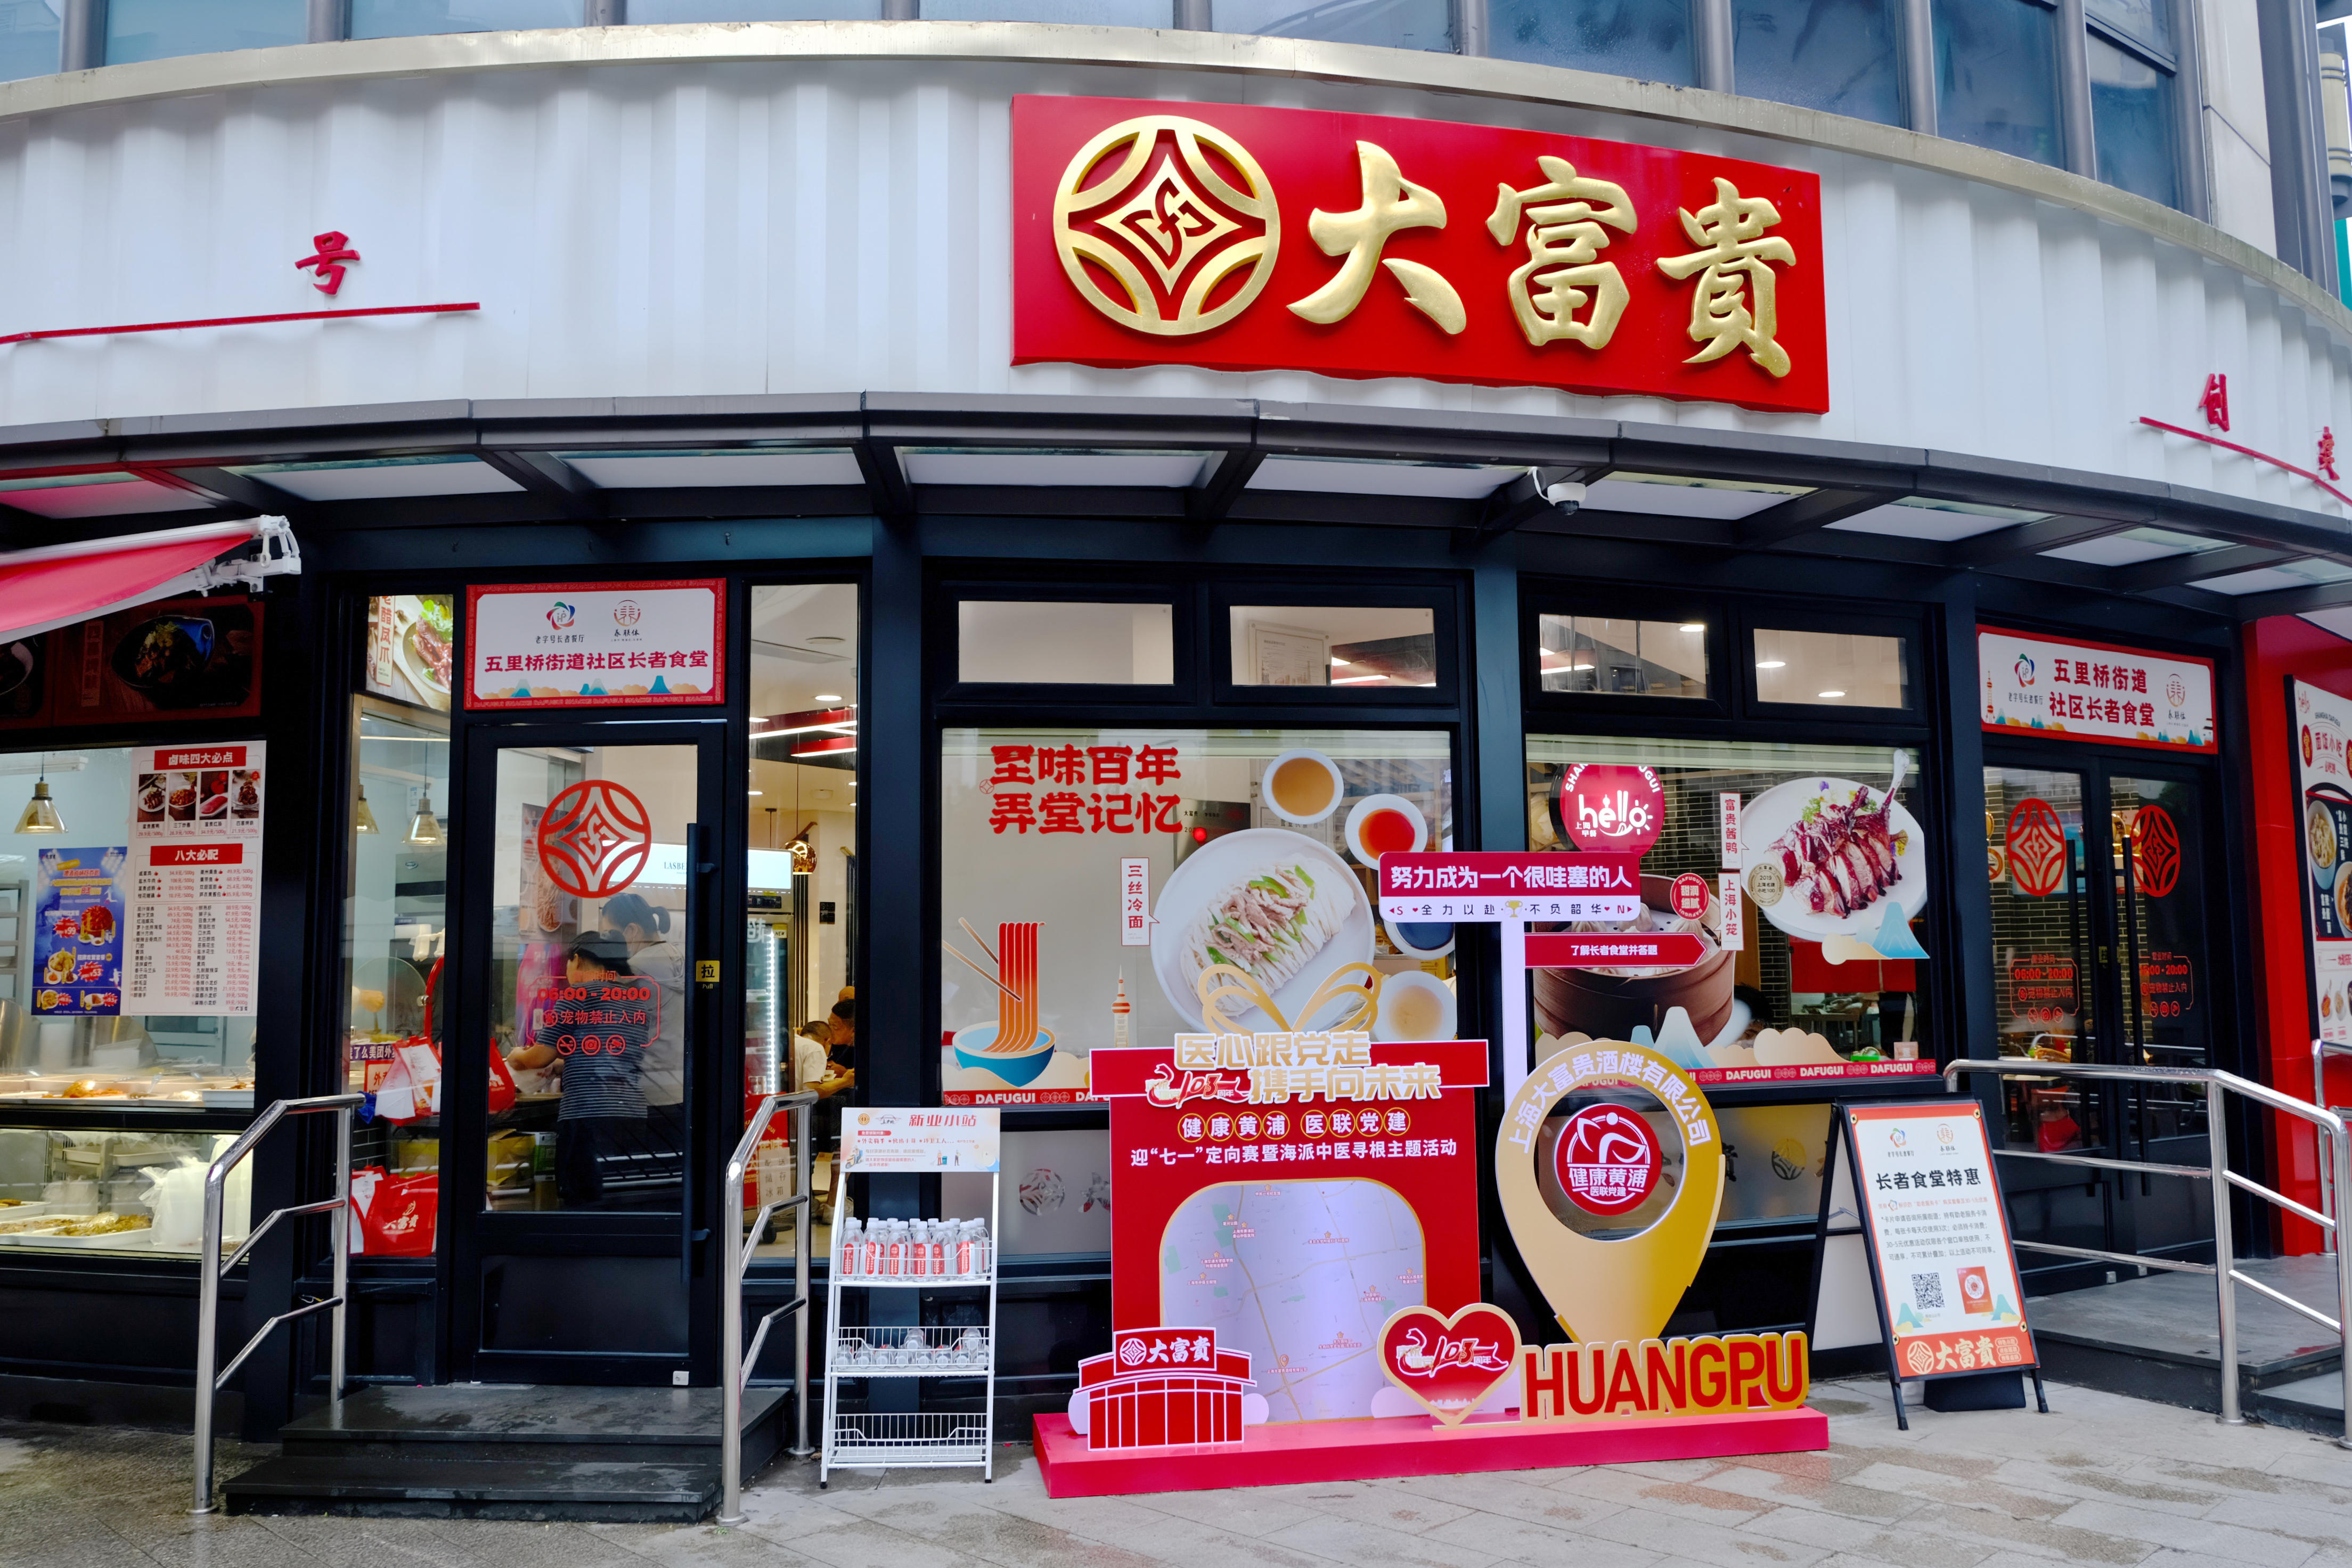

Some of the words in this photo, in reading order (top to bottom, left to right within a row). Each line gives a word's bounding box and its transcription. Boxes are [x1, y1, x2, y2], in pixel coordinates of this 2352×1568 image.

[295, 231, 361, 296] 号
[1287, 140, 1796, 378] 大富貴
[535, 634, 585, 643] 老字号长者餐厅
[485, 650, 708, 672] 五里桥街道社区长者食堂
[2054, 658, 2147, 693] 五里桥街道
[2049, 691, 2154, 727] 社区长者食堂
[169, 752, 233, 765] 卤味四大必点
[990, 744, 1181, 786] 至味百年
[1578, 790, 1647, 830] hello
[1725, 798, 1737, 854] 富贵酱鸭
[175, 849, 218, 861] 八大必配
[1391, 865, 1632, 889] 努力成为一个很哇塞的人
[1678, 877, 1702, 885] DAFUGUI
[1128, 864, 1143, 929] 三丝冷面
[1724, 879, 1737, 936] 上海小笼
[1396, 906, 1403, 916] S
[1421, 904, 1496, 916] 全力以赴
[1530, 903, 1603, 915] 不负韶华
[1617, 905, 1625, 914] N
[1570, 945, 1658, 957] 了解长者食堂并答题
[701, 964, 715, 978] 拉
[2014, 968, 2041, 979] 06:00
[2048, 968, 2073, 979] 20:00
[2166, 965, 2188, 975] 20:00
[600, 987, 650, 1001] 20:00
[560, 1010, 646, 1024] 宠物禁止入内
[1174, 1032, 1371, 1069] 医心跟党走
[1726, 1069, 1771, 1081] DAFUGUI
[1800, 1066, 1844, 1077] DAFUGUI
[1871, 1062, 1913, 1074] DAFUGUI
[1249, 1063, 1441, 1104] 携手向未来
[976, 1093, 1035, 1104] DAFUGUI
[1508, 1050, 1711, 1154] 上海大富贵酒楼有限公司
[909, 1114, 977, 1127] 新业小站
[1182, 1115, 1286, 1139] 健康黄浦
[1305, 1110, 1407, 1134] 医联党建
[1569, 1167, 1648, 1187] 健康黄浦
[1876, 1167, 1981, 1191] 长者食堂特惠
[1590, 1186, 1627, 1197] 医联党建
[1147, 1336, 1211, 1363] 大富貴
[1474, 1356, 1491, 1365] 周年
[1936, 1336, 1996, 1370] 大富貴
[1524, 1337, 1803, 1418] HUANGPU
